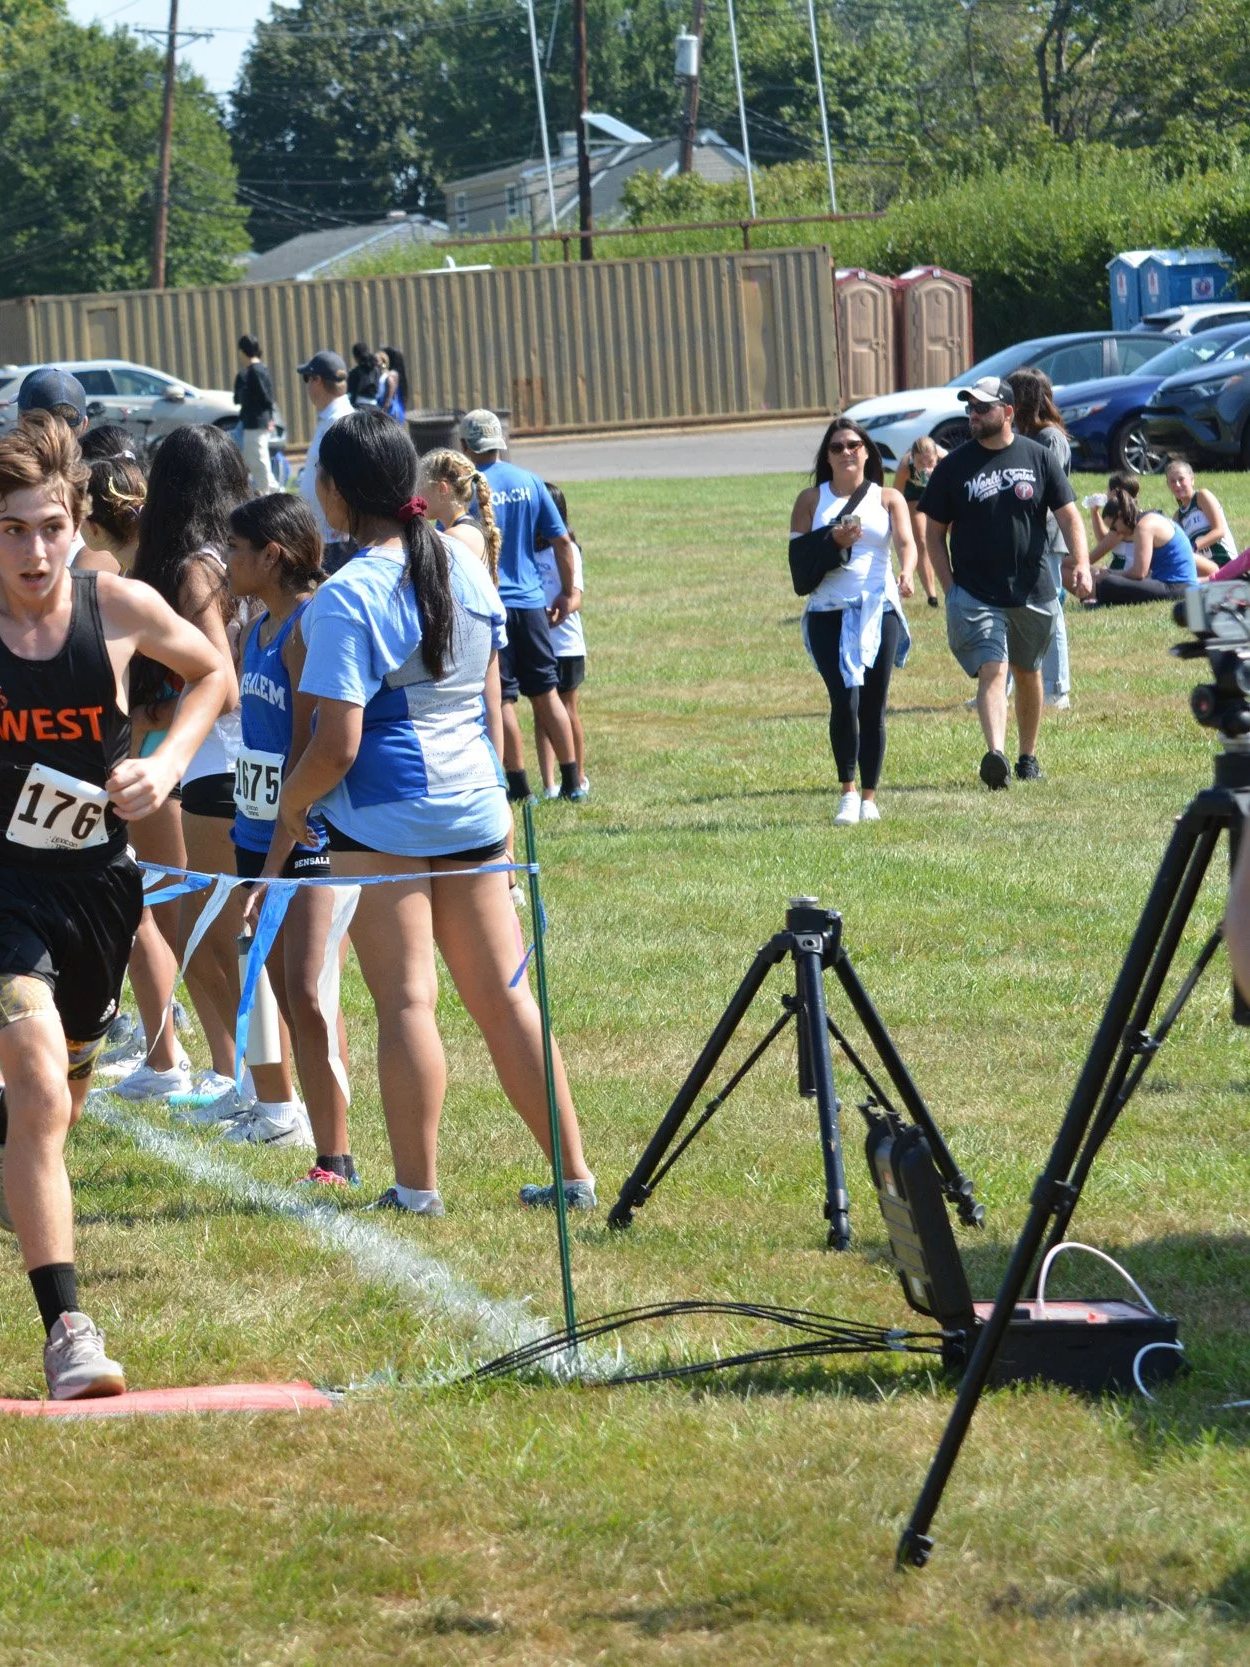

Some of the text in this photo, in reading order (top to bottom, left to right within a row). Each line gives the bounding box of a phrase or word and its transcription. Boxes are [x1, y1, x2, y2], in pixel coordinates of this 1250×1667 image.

[491, 487, 531, 507] OACH
[964, 468, 1037, 502] World Series
[235, 757, 280, 805] 1675
[17, 782, 103, 840] 176
